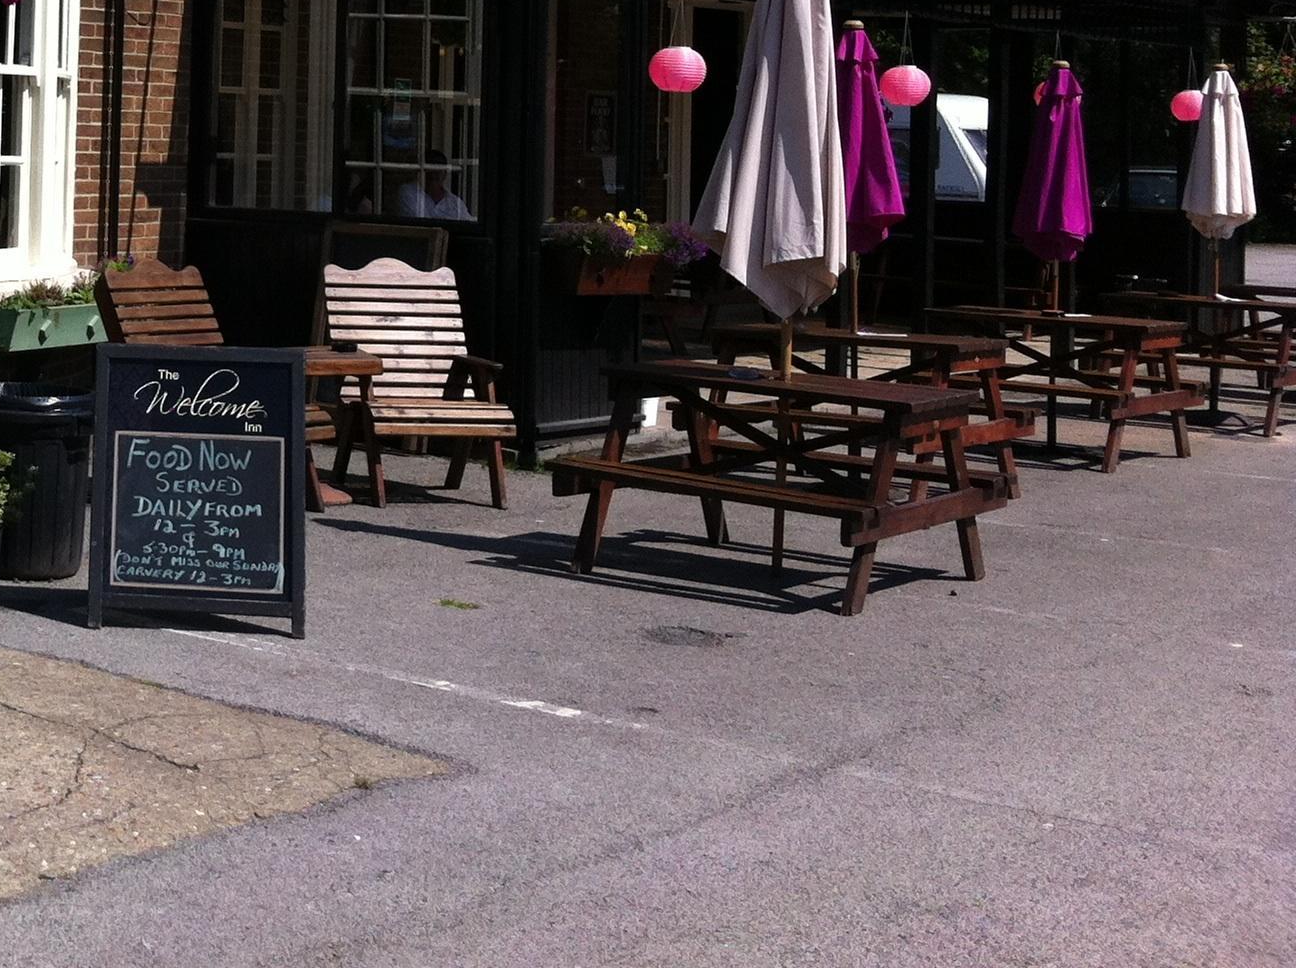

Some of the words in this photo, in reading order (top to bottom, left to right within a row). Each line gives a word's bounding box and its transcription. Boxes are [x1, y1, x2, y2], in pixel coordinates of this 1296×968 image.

[157, 369, 180, 381] The
[133, 368, 268, 419] Welcome
[244, 421, 262, 433] Inn
[126, 438, 193, 471] FOOD
[199, 440, 252, 471] NOW
[156, 471, 242, 496] SERVED
[132, 495, 203, 521] DAILY
[204, 502, 263, 518] FROM
[154, 519, 177, 533] 12
[171, 556, 201, 567] MISS
[206, 559, 230, 570] OUR
[116, 565, 185, 580] CARVERY
